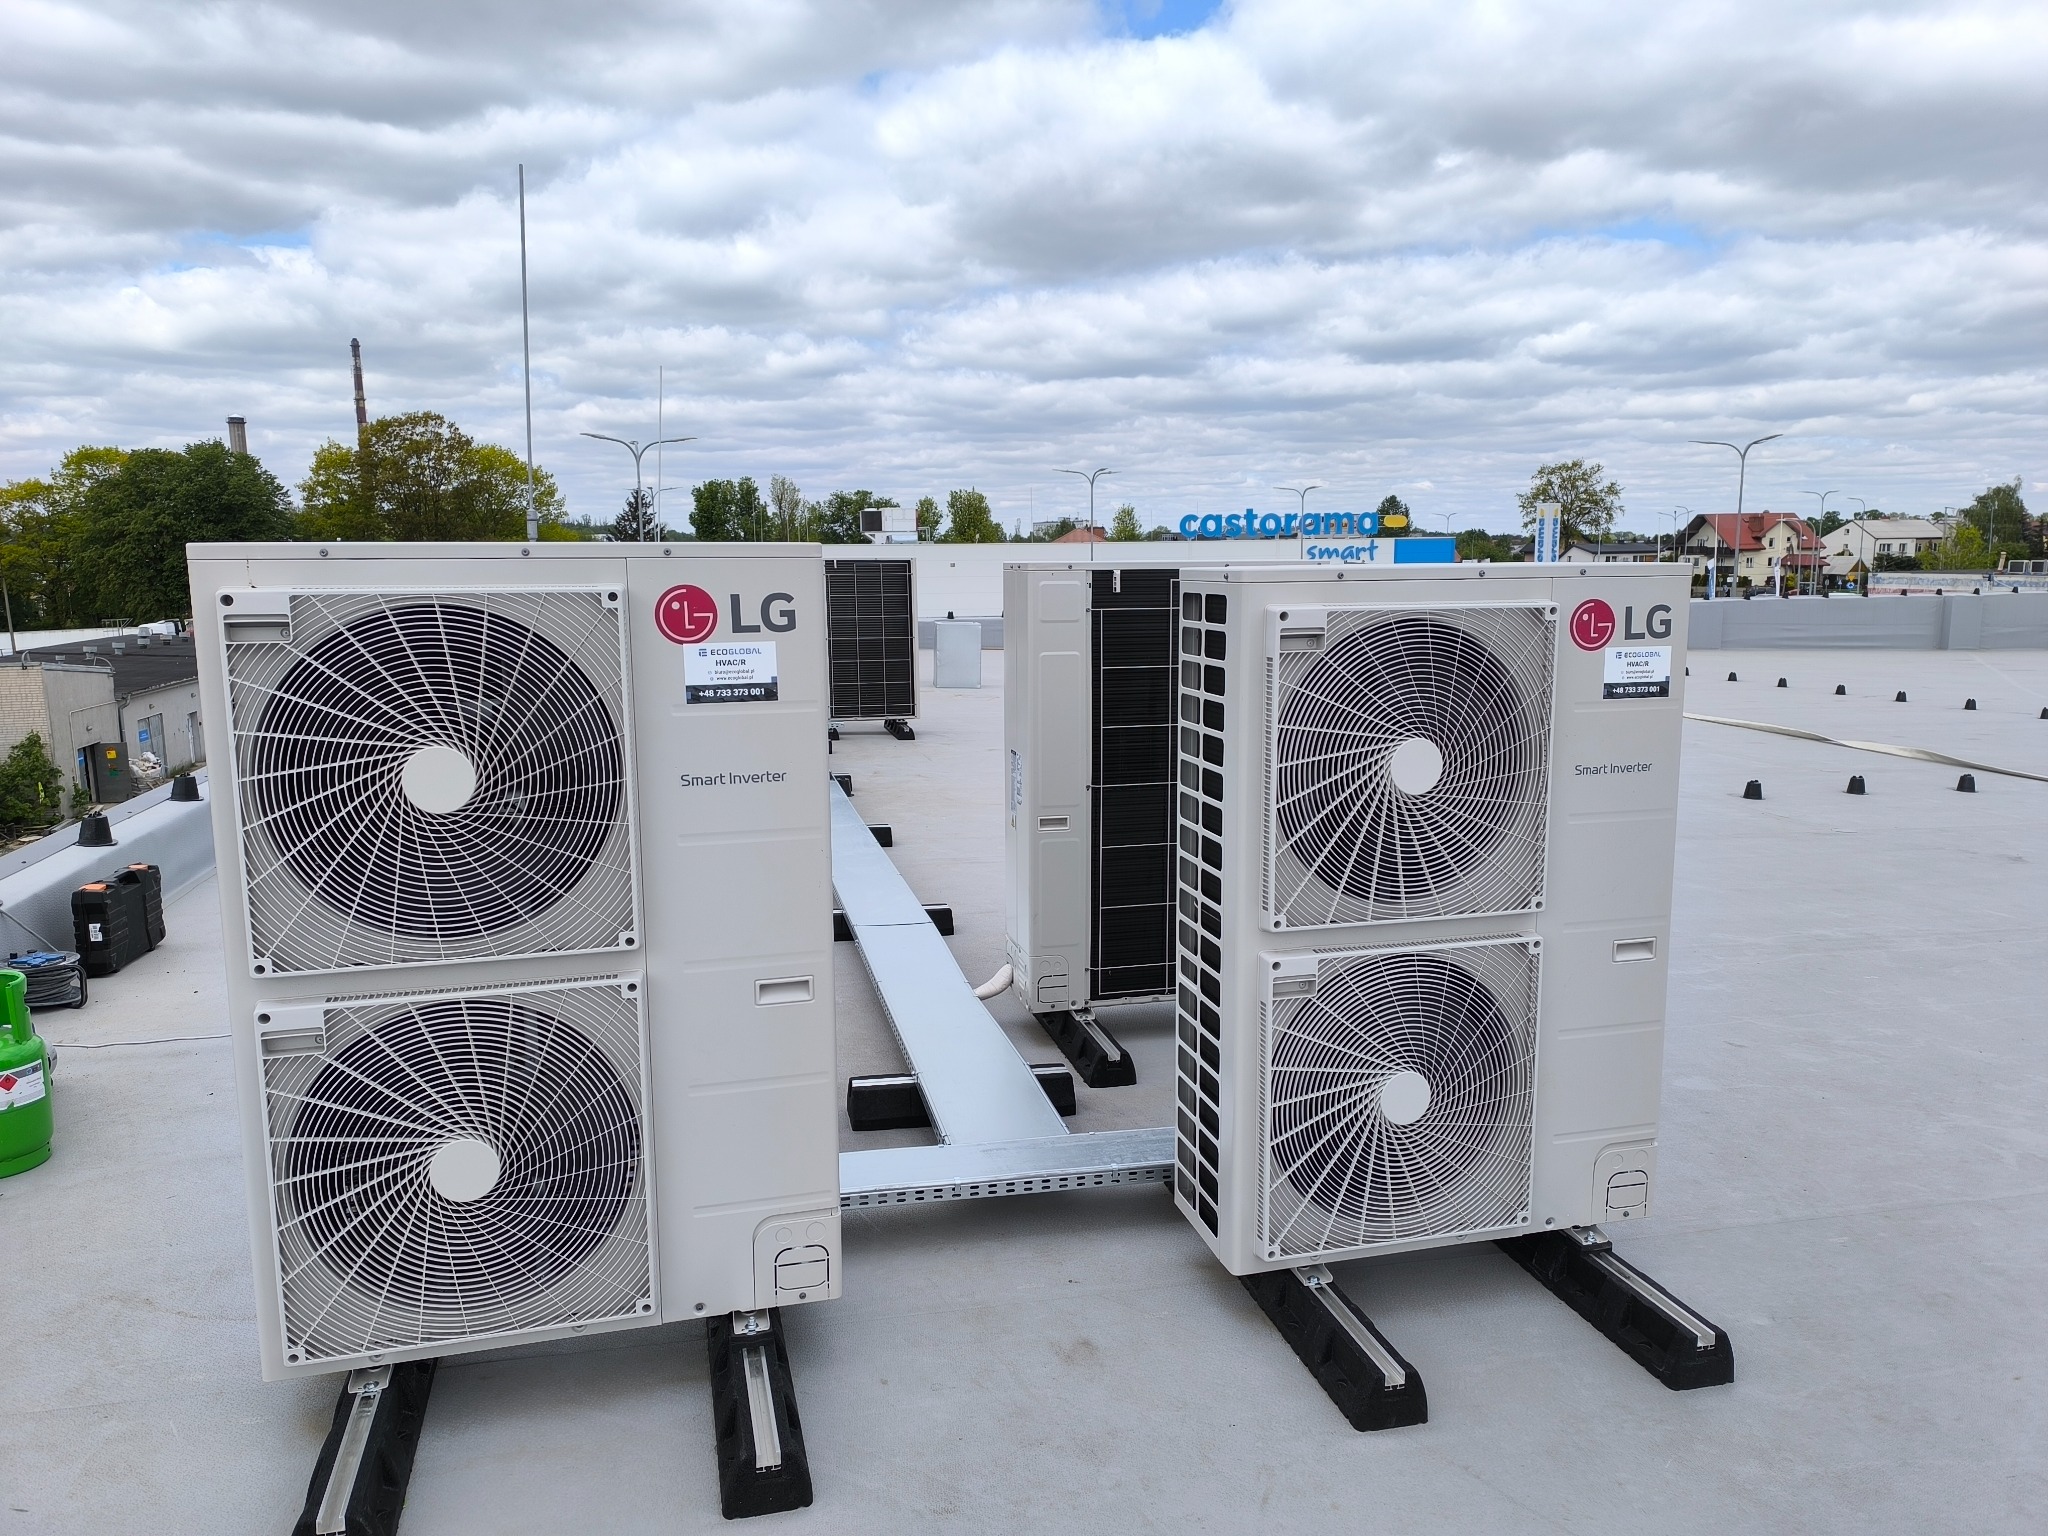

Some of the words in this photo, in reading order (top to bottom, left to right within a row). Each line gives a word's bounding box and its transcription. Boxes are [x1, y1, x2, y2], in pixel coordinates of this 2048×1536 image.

[1179, 508, 1379, 538] castorama
[1306, 539, 1379, 561] smart
[730, 592, 797, 634] LG
[1624, 604, 1672, 640] LG
[710, 647, 762, 656] ECOGLOBAL
[1623, 651, 1661, 659] ECOGLOBAL
[715, 659, 747, 667] HVAC/R
[698, 689, 715, 698] +48
[716, 689, 732, 697] 733
[733, 688, 749, 696] 373
[750, 687, 765, 696] 001
[1649, 685, 1660, 693] 001
[1574, 763, 1609, 776] Smart
[1610, 761, 1653, 774] Inverter
[680, 773, 726, 787] Smart
[729, 770, 787, 785] Inverter
